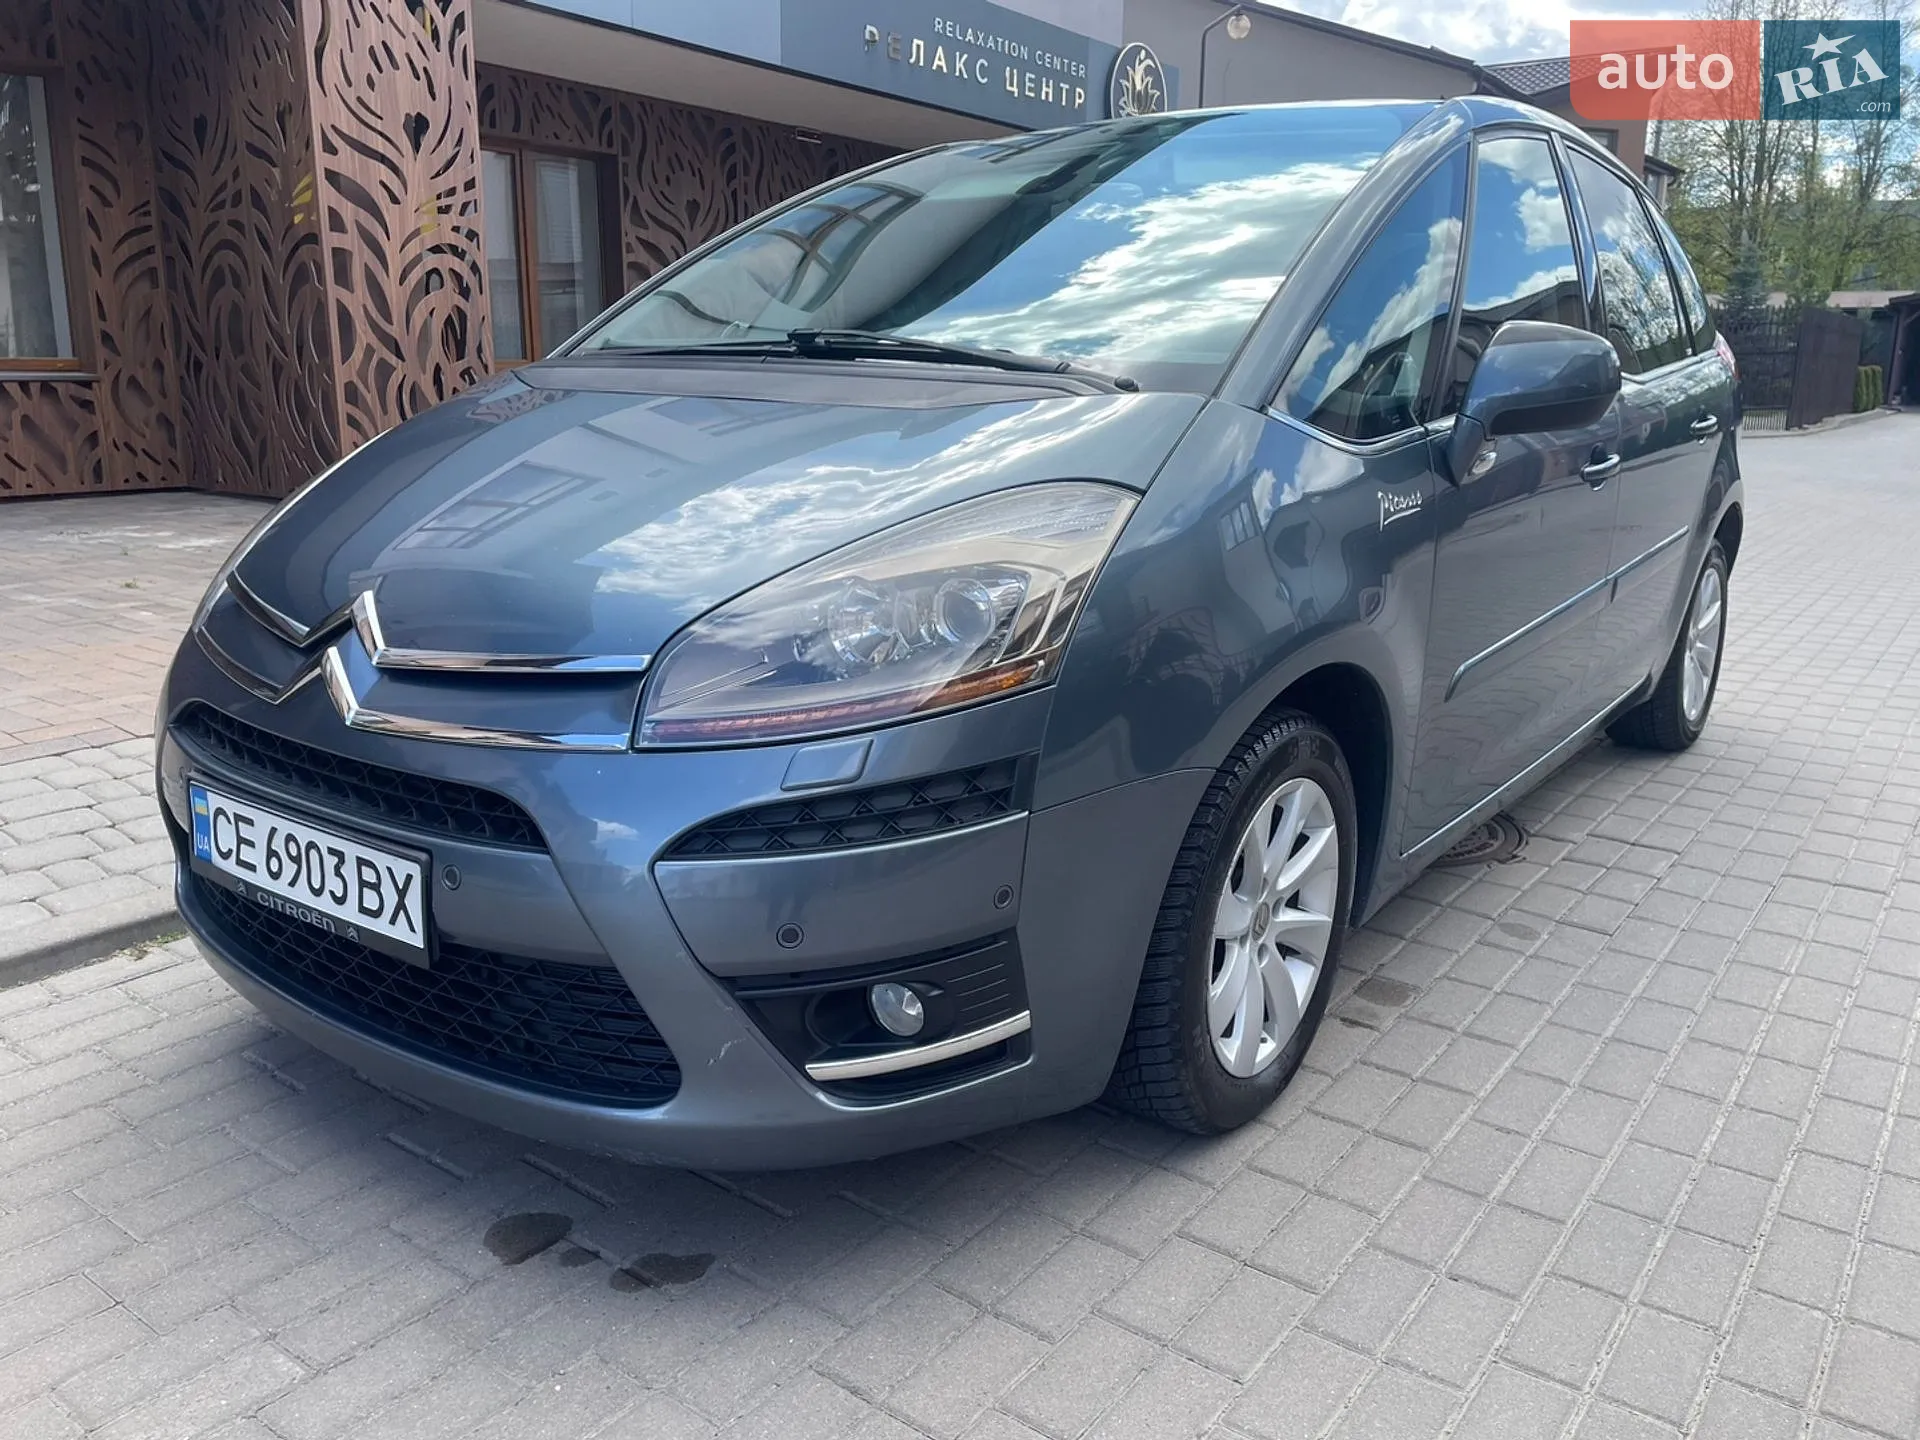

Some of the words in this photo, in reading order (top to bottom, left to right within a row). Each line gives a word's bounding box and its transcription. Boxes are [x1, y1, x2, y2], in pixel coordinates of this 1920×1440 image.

[864, 25, 989, 85] РЕЛАКС
[1005, 66, 1085, 109] ЦЕНТР
[934, 17, 1028, 61] RELAXATION
[1035, 50, 1087, 78] CENTER
[196, 833, 210, 851] UA
